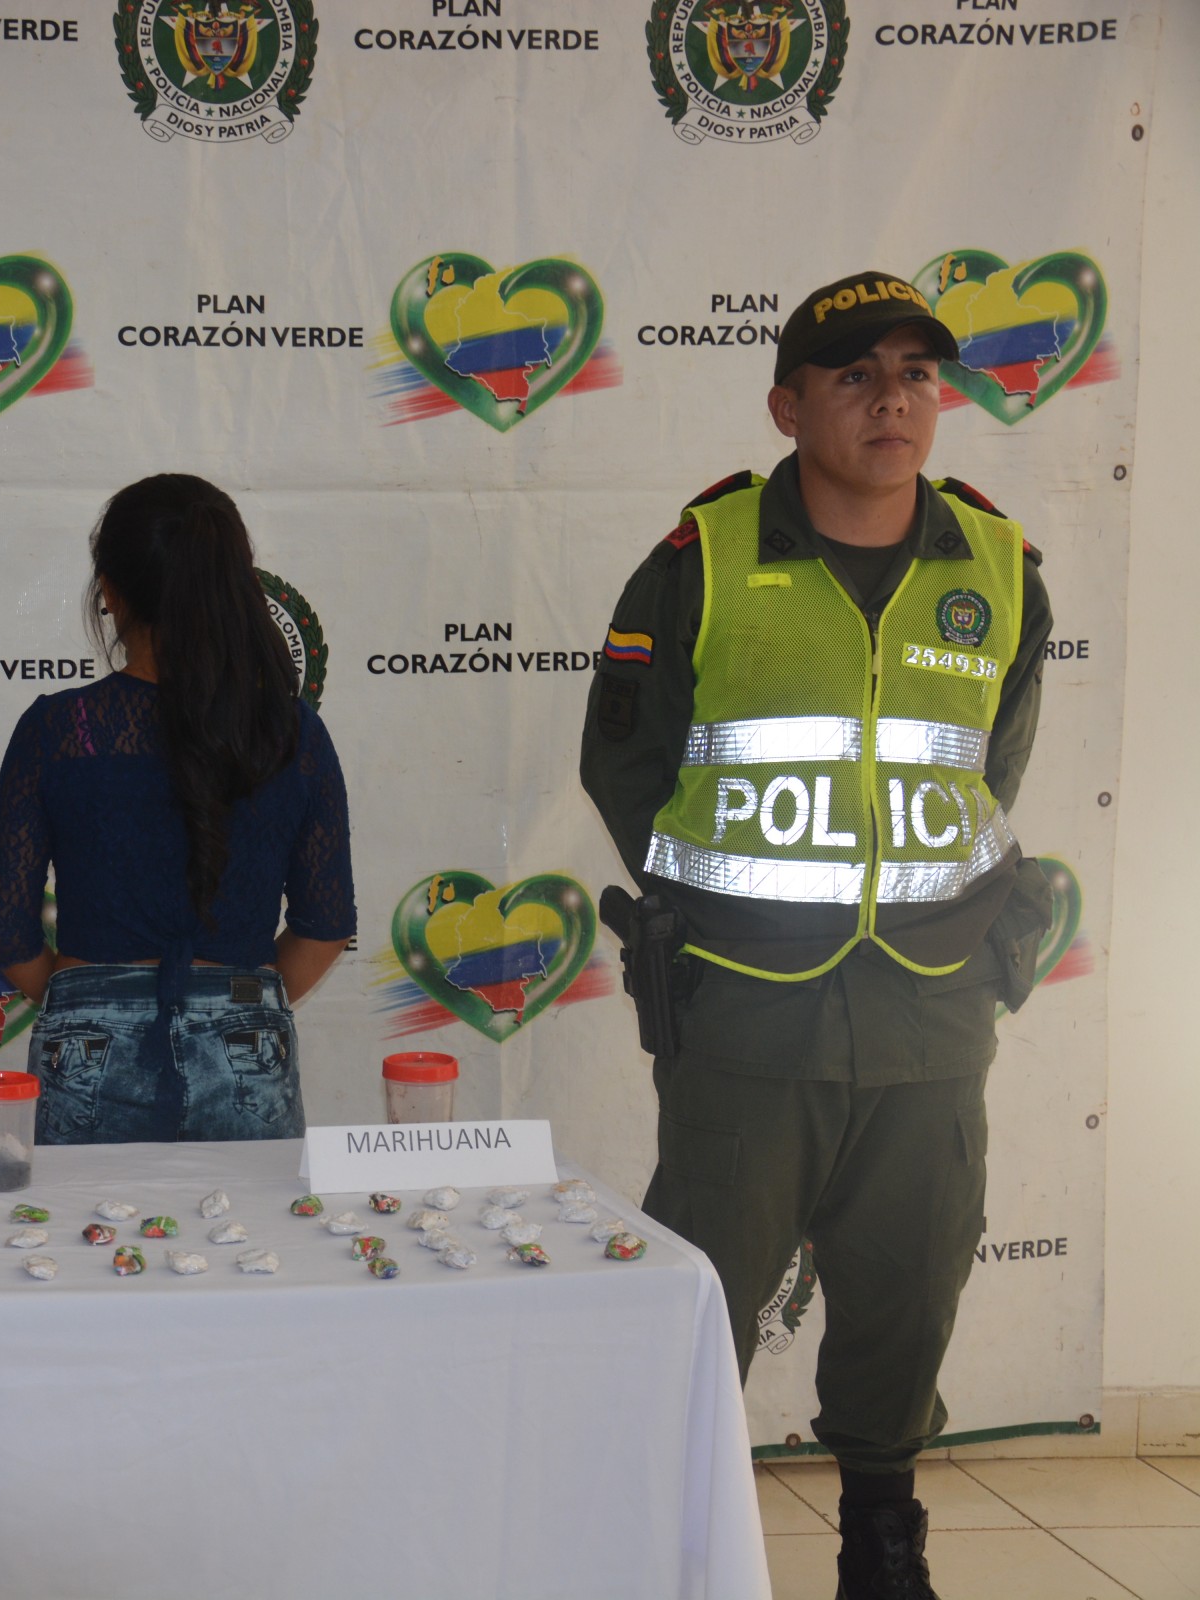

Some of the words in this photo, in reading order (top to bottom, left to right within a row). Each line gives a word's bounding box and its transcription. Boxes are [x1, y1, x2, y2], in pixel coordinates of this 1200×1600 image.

[432, 0, 501, 17] PLAN
[354, 24, 502, 50] CORAZÓN
[507, 29, 599, 50] VERDE
[875, 17, 1015, 46] CORAZÓN
[1019, 19, 1117, 45] VERDE
[219, 69, 288, 118] NACIONAL
[750, 66, 818, 119] NACIONAL
[218, 114, 272, 138] PATRIA
[749, 115, 800, 139] PATRIA
[197, 294, 265, 314] PLAN
[711, 294, 778, 313] PLAN
[117, 320, 266, 347] CORAZÓN
[271, 327, 363, 348] VERDE
[637, 319, 780, 346] CORAZÓN
[267, 598, 303, 676] OLOMBI
[444, 623, 512, 642] PLAN
[367, 647, 512, 675] CORAZÓN
[905, 644, 998, 680] 254938
[1043, 639, 1090, 661] RDE
[0, 658, 95, 680] VERDE
[346, 1127, 512, 1154] MARIHUANA
[991, 1237, 1068, 1262] VERDE
